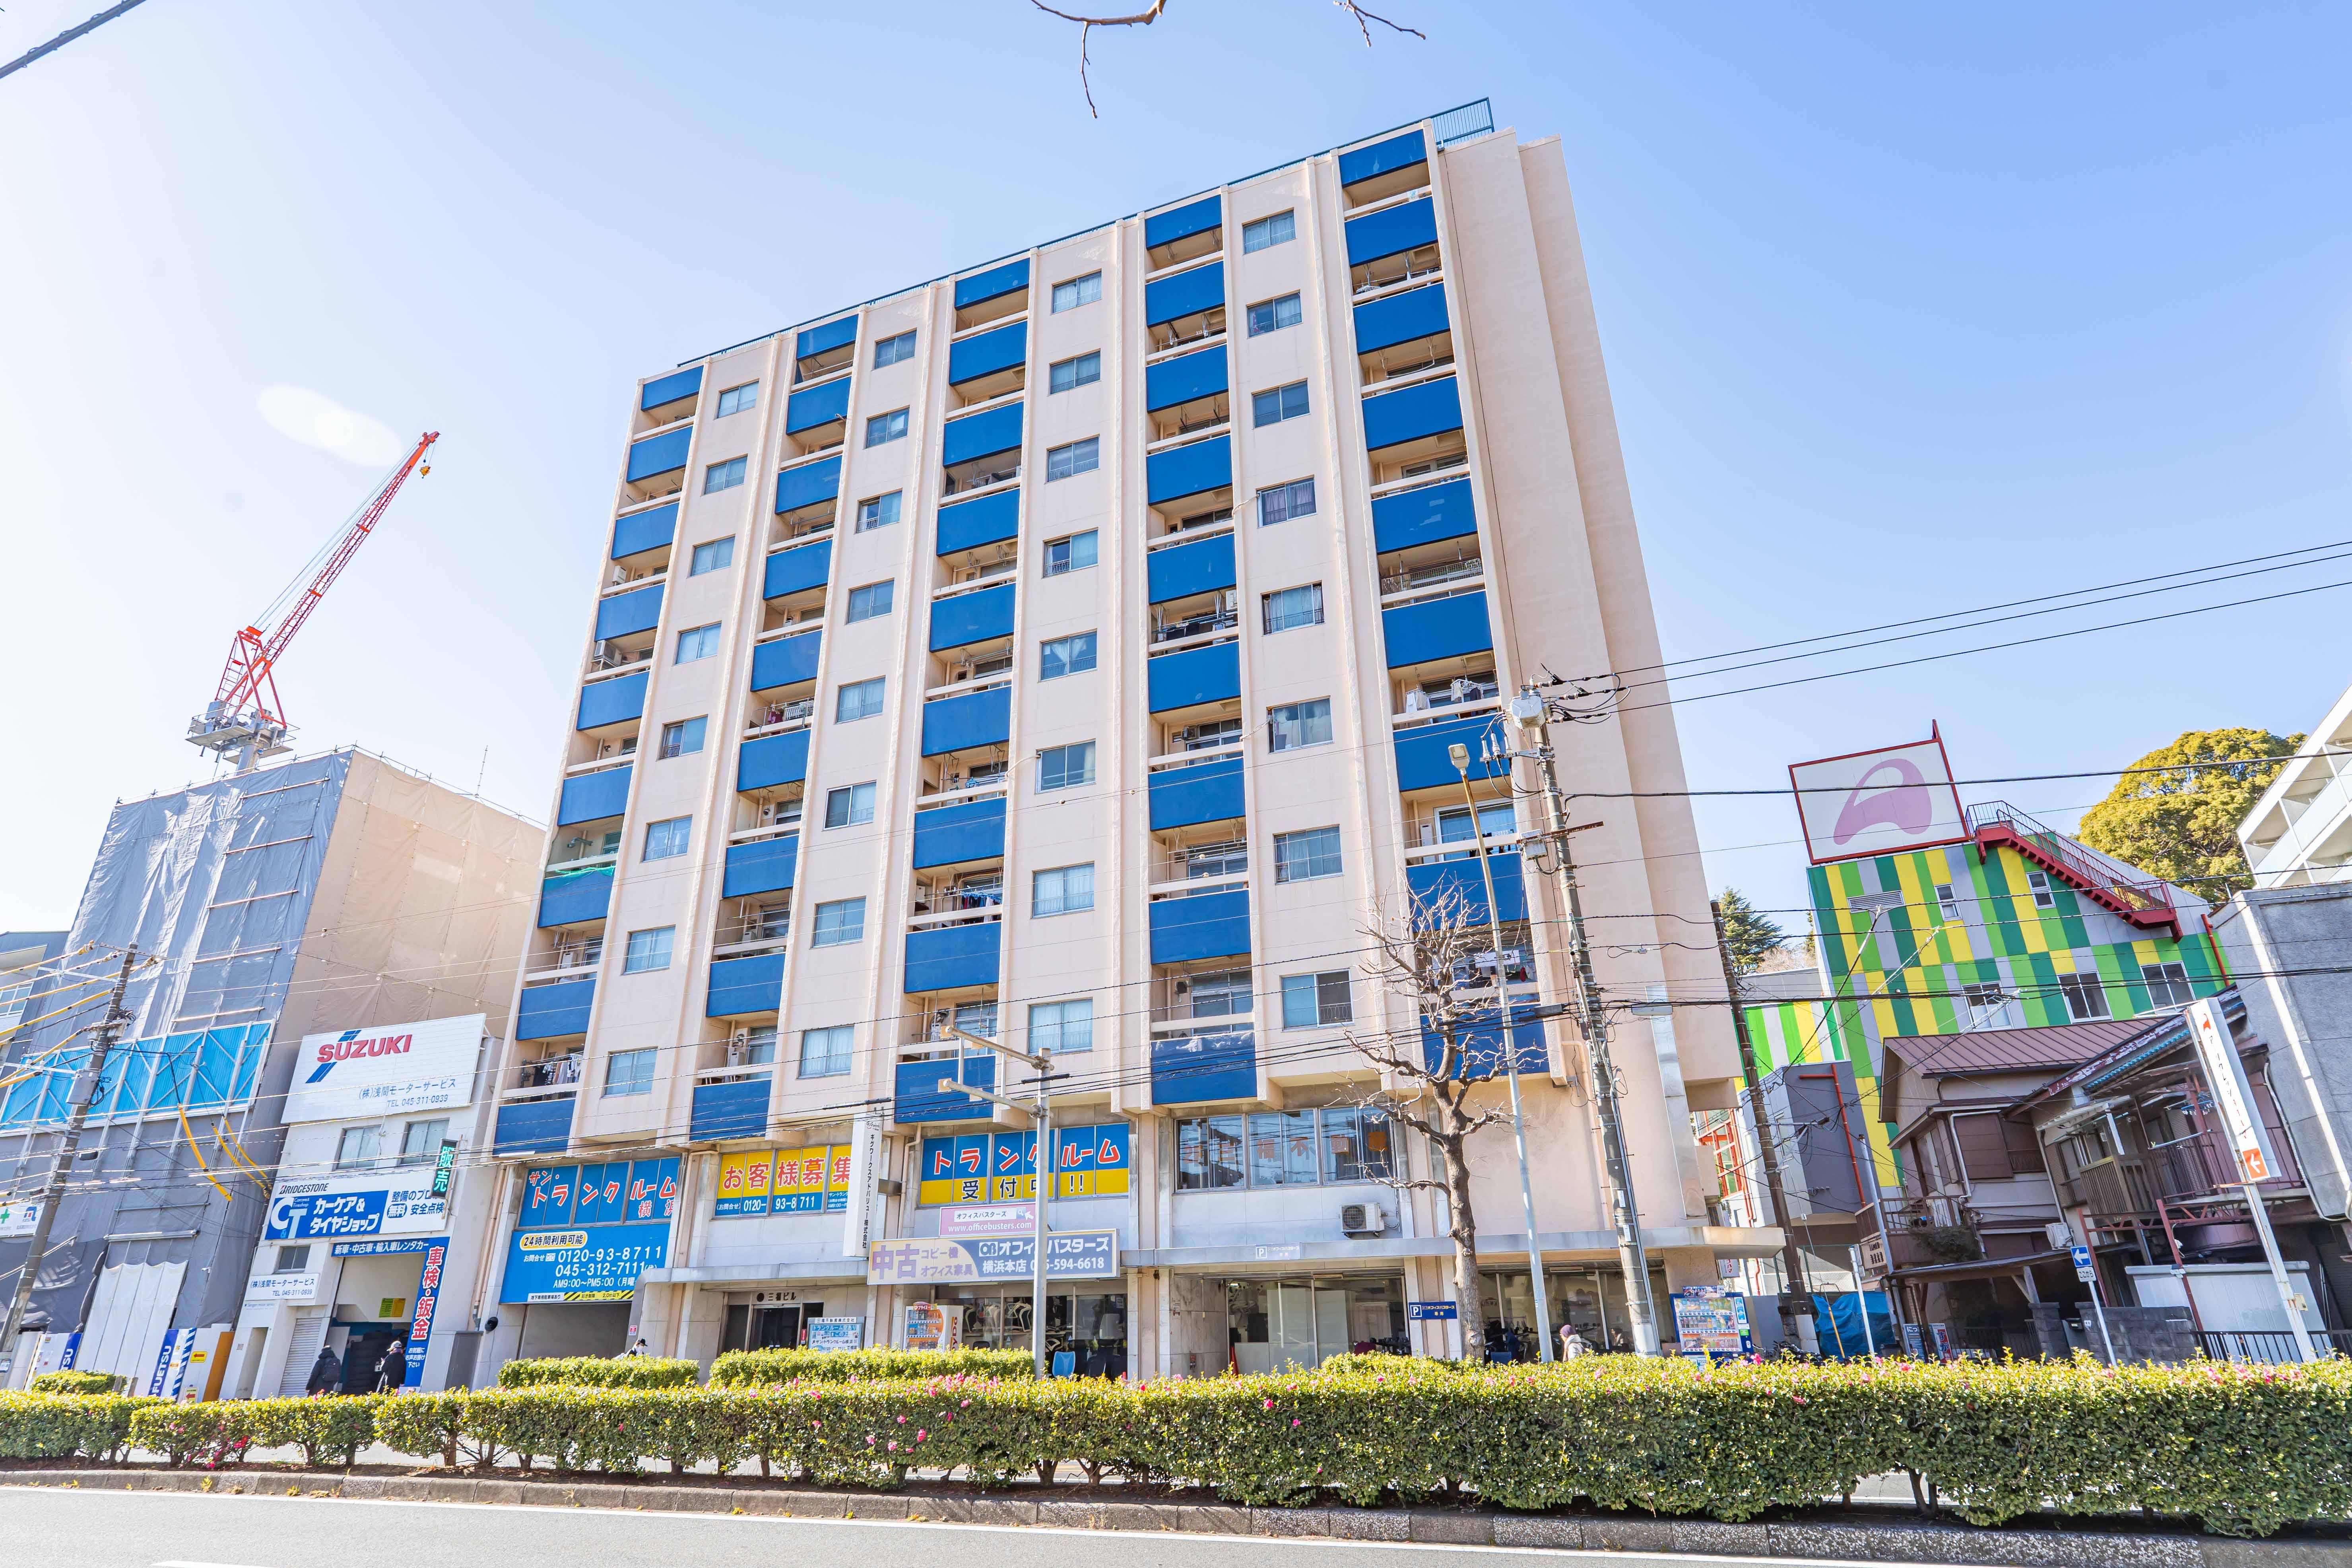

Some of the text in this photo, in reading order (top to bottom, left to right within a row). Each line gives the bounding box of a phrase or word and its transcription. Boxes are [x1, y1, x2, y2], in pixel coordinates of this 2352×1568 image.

[317, 1034, 413, 1063] SUZUKI
[359, 1078, 456, 1100] (株)浅間モーターサービス
[402, 1094, 448, 1106] 045-311-0939
[433, 1146, 455, 1192] 販売
[722, 1156, 851, 1190] お客様募集
[279, 1183, 329, 1195] BRIDGESTONE
[391, 1189, 437, 1203] 整備のプロ
[532, 1176, 675, 1209] トランクルーム
[862, 1133, 875, 1249] ギグワークスアドバリュー株式会社
[313, 1196, 365, 1215] カーケア&
[388, 1202, 444, 1217] 無料 安全点検
[743, 1195, 815, 1211] 0120-93-8711
[309, 1213, 380, 1234] タイヤショップ
[957, 1211, 1007, 1219] オフィスバスターズ
[948, 1222, 1032, 1232] www.officebusters.com
[523, 1234, 584, 1247] 24時間利用可能
[999, 1237, 1109, 1256] オフィバスターズ
[523, 1246, 662, 1263] お問合せ 0120-93-8711
[1259, 1248, 1264, 1257] P
[872, 1244, 959, 1280] 中古 コピー機
[921, 1264, 973, 1277] オフィス家具
[983, 1257, 1104, 1274] 横浜本店 05-594-6618
[617, 1276, 636, 1287] (月曜
[411, 1246, 445, 1340] 車検・鈑金
[1413, 1307, 1419, 1316] P
[151, 1345, 171, 1393] FUETSU
